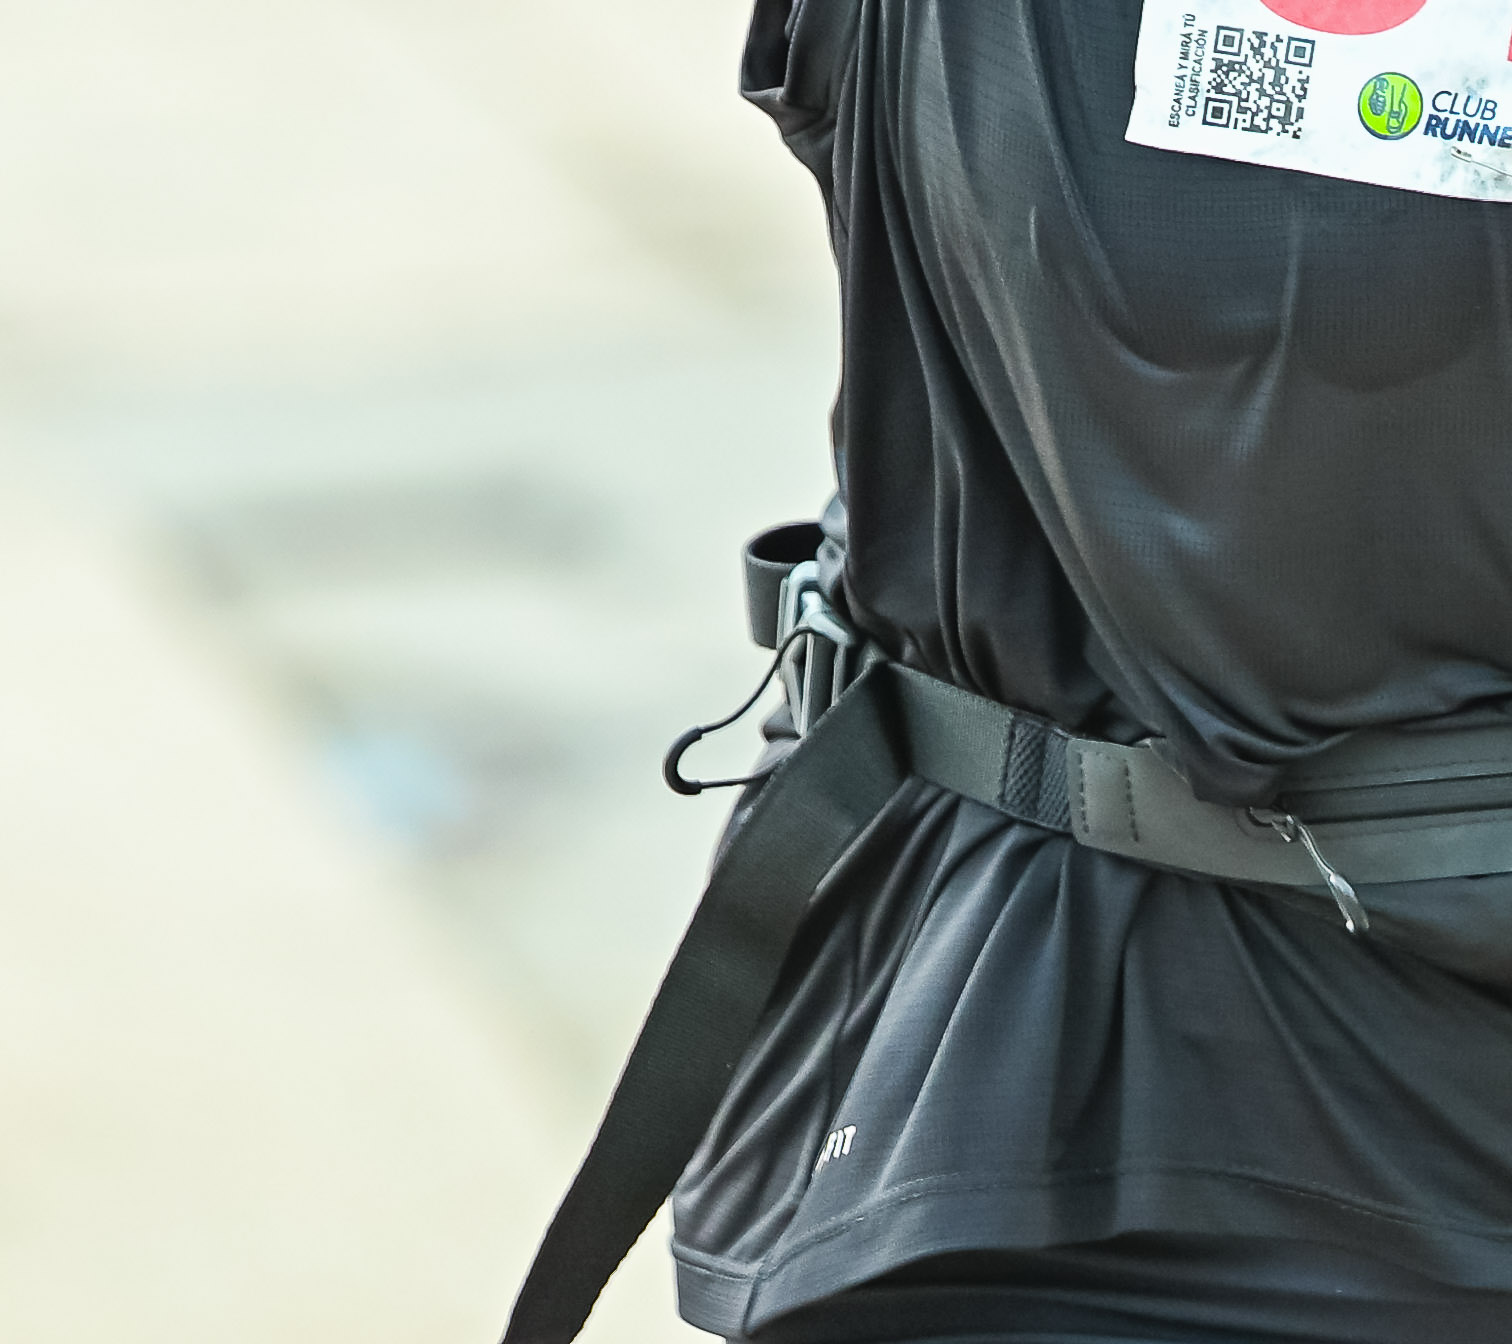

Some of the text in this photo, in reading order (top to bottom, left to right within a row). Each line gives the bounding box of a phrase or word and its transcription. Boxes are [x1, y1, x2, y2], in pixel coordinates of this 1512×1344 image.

[1168, 74, 1187, 128] ESCANEÁ
[1179, 32, 1193, 61] MIRÁ
[1185, 29, 1208, 117] CLASIFICACIÓN
[1432, 90, 1498, 121] CLUB
